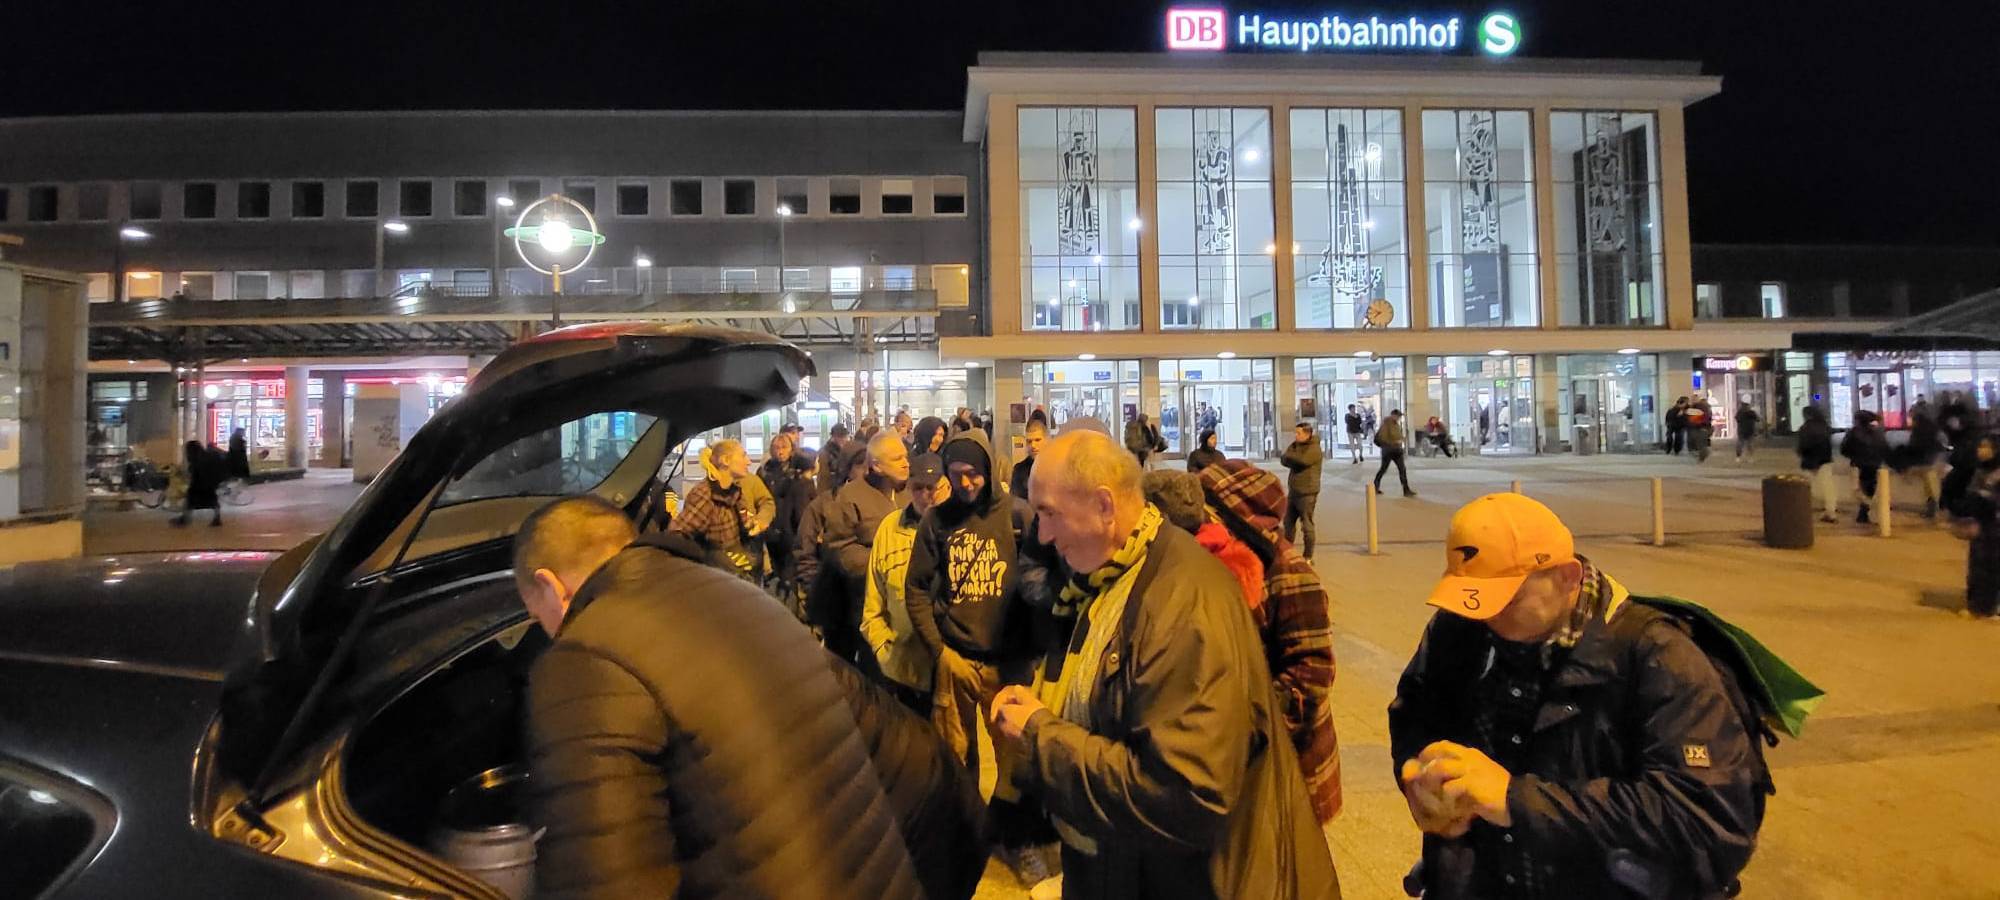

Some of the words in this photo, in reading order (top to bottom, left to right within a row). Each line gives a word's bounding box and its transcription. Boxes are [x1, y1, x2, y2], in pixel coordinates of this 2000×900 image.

[1175, 16, 1218, 42] DB
[1238, 14, 1460, 52] Hauptbahnhof
[1484, 14, 1516, 54] S
[949, 543, 975, 562] MIR
[1461, 587, 1481, 611] 3
